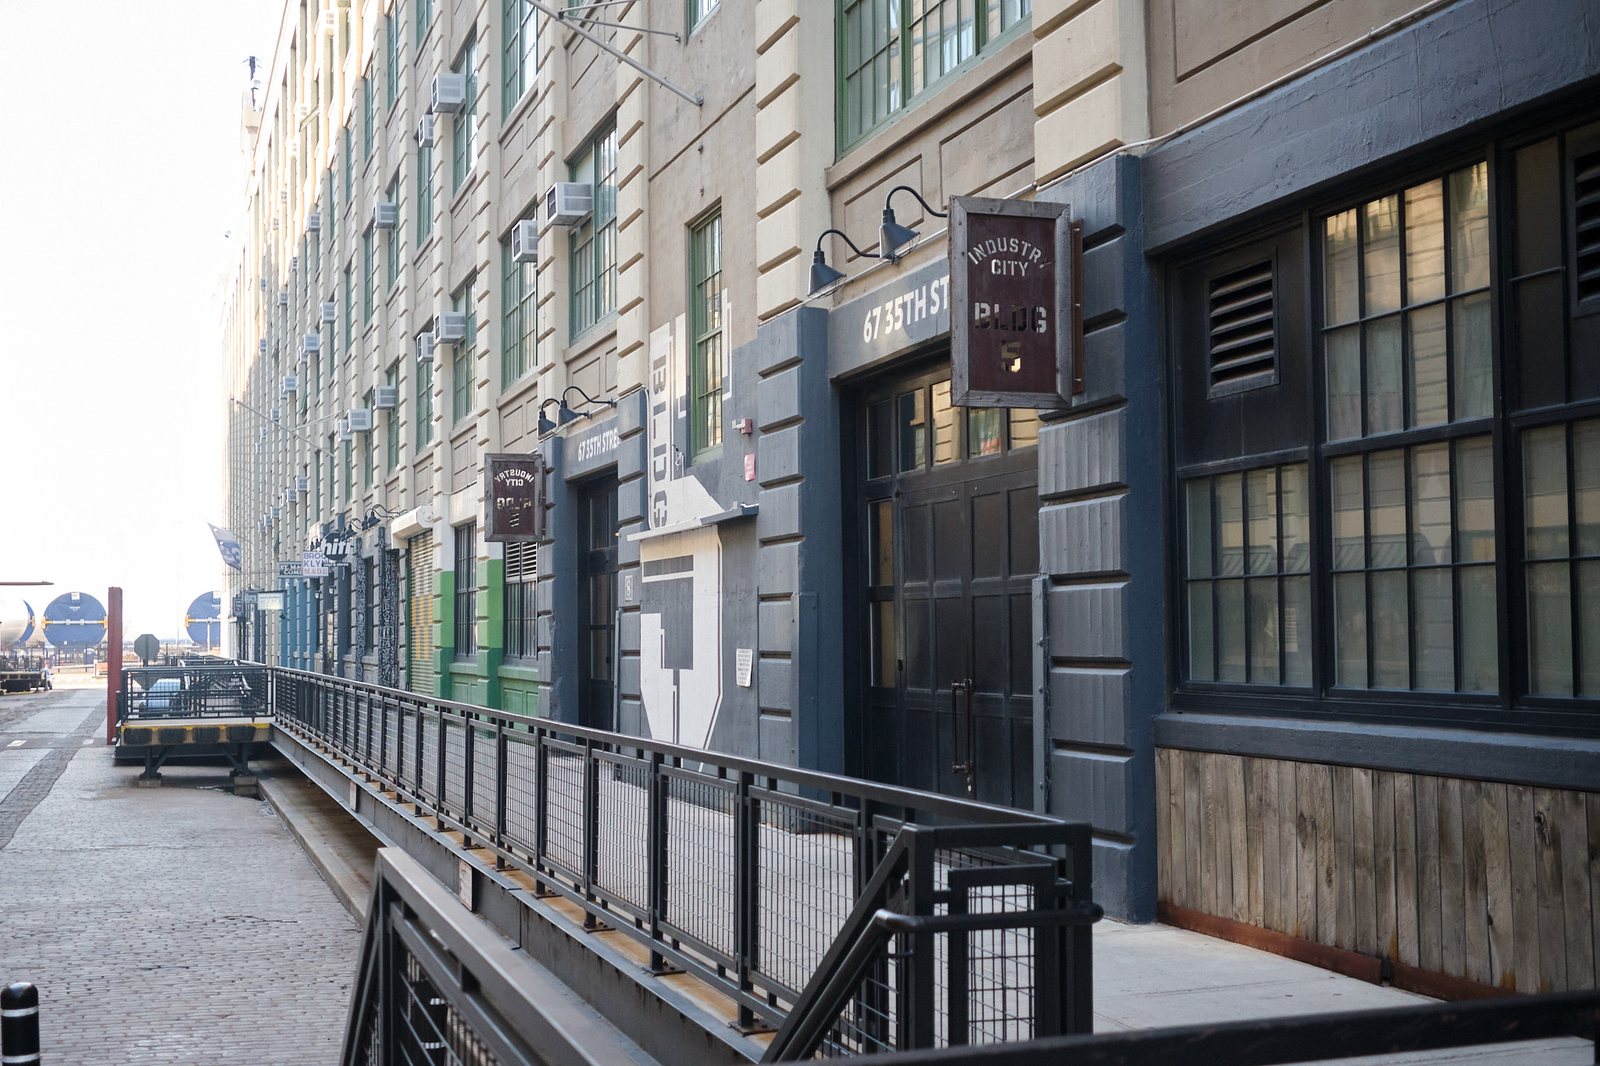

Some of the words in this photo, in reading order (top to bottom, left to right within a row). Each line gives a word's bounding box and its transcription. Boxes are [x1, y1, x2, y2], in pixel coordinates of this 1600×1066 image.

[991, 258, 1029, 277] CITY
[863, 307, 881, 343] 67
[885, 285, 927, 334] 35TH
[974, 302, 1047, 334] BLDG
[1000, 340, 1022, 373] 5
[578, 440, 586, 462] 67
[652, 354, 668, 527] BLDG
